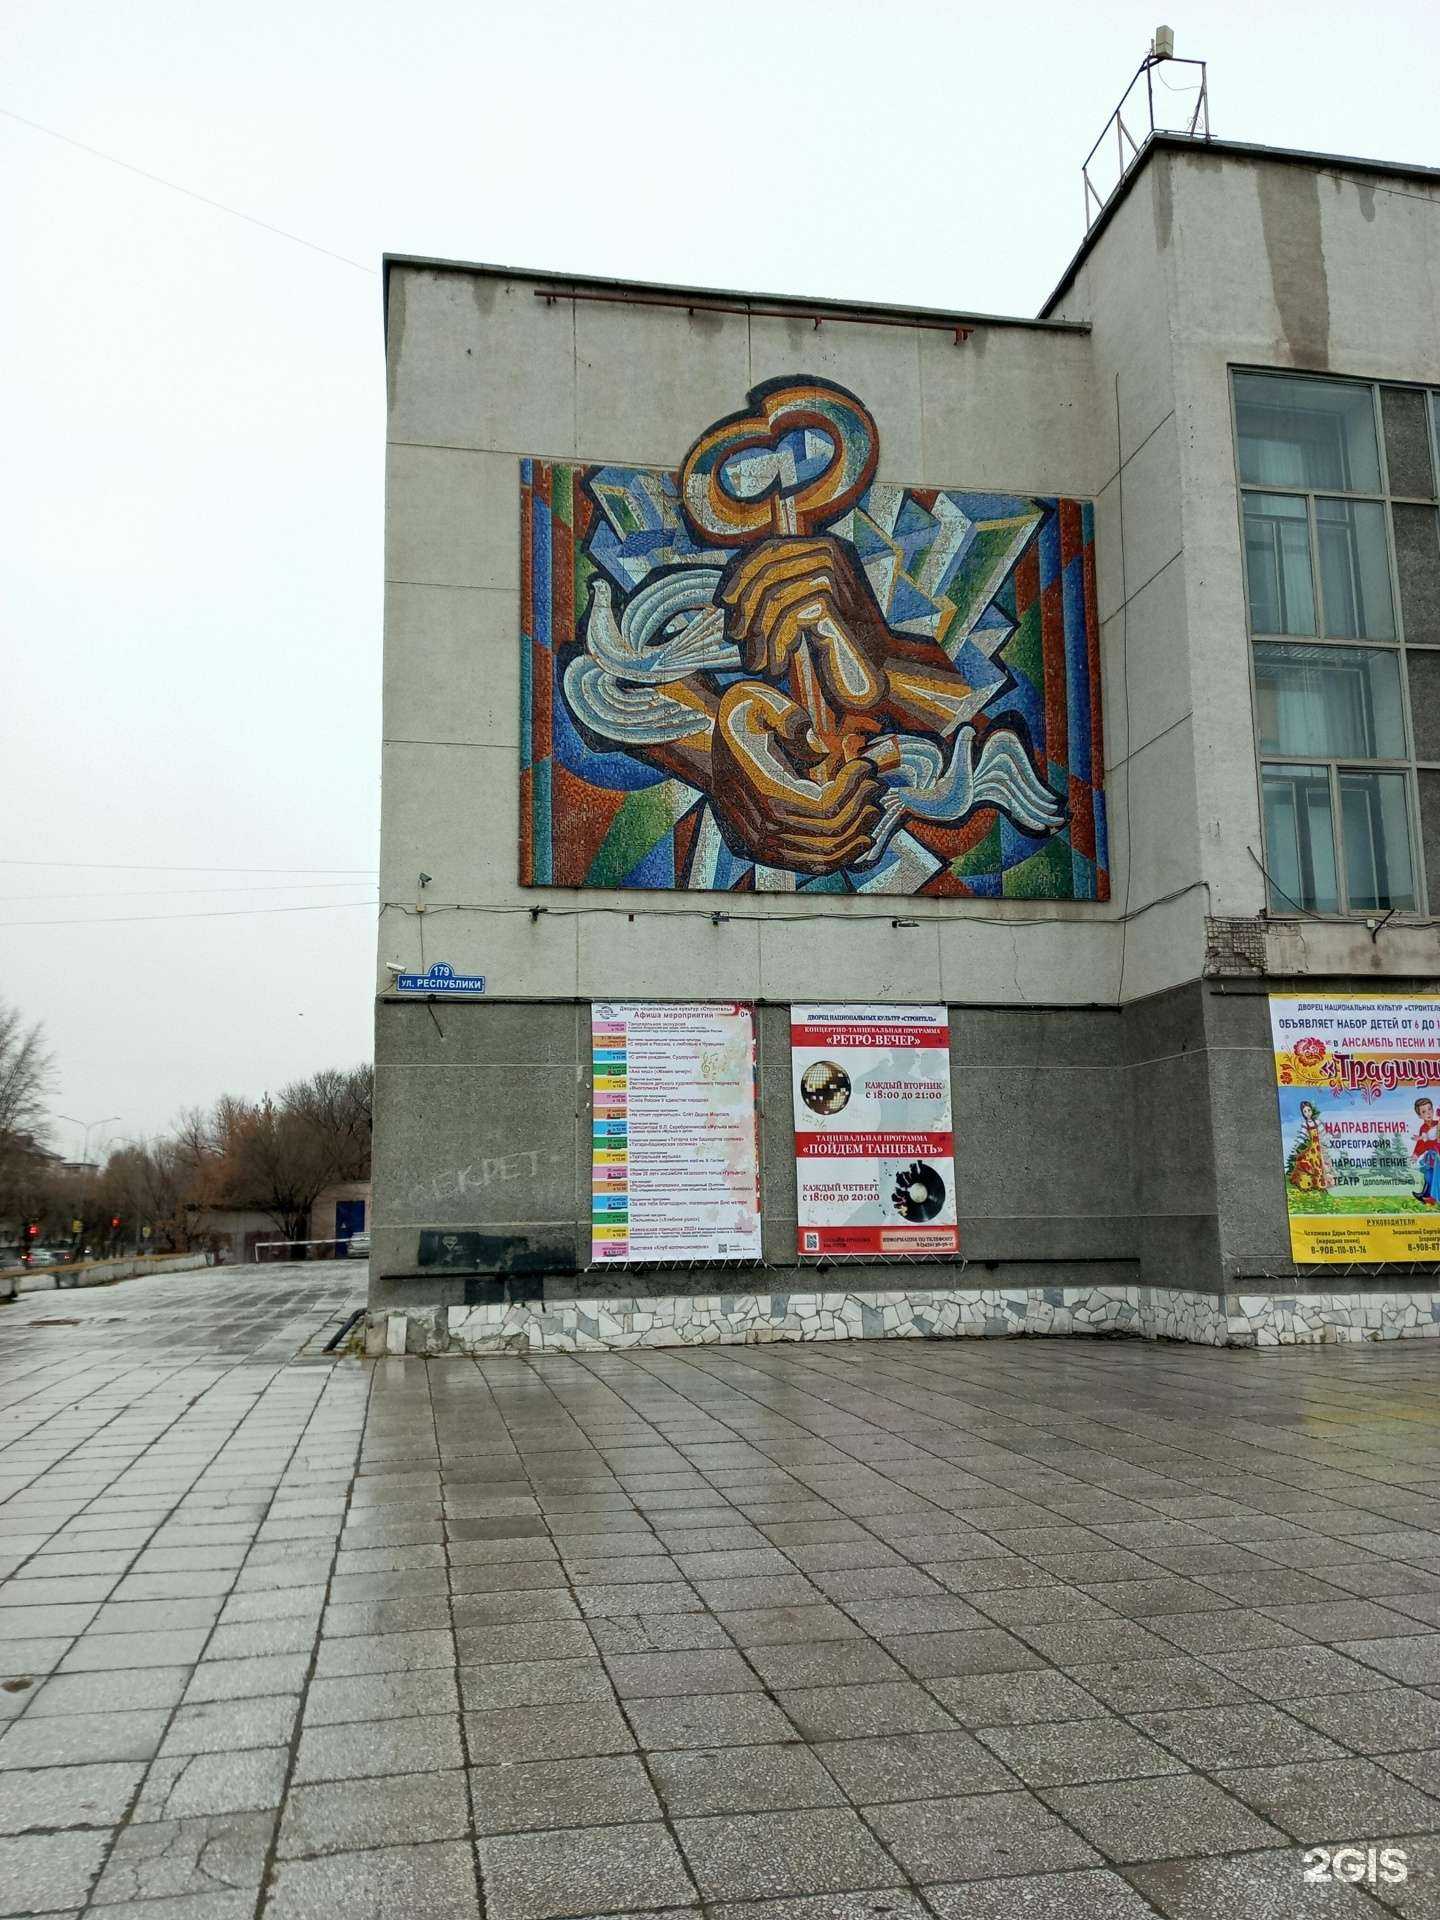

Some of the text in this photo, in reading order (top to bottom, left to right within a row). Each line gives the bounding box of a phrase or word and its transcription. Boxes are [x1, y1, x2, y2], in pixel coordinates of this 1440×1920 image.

[434, 966, 450, 976] 179
[417, 979, 481, 989] РЕСПУБЛИКИ
[1298, 1003, 1324, 1011] ДВОРЕЦ
[1325, 1003, 1375, 1011] НАЦИОНАЛЬНЫХ
[634, 1011, 661, 1019] Афиша
[1279, 1018, 1334, 1029] ОБЪЯВЛЯЕТ
[1337, 1019, 1367, 1029] НАБОР
[1370, 1017, 1399, 1030] ДЕТЕЙ
[1401, 1019, 1412, 1029] ОТ
[1414, 1020, 1420, 1029] 6
[1422, 1019, 1435, 1030] ДО
[826, 1034, 921, 1046] «РЕТРО-ВЕЧЕР»
[1342, 1038, 1393, 1047] АНСАМБЛЬ
[1396, 1038, 1426, 1047] ПЕСНИ
[1428, 1038, 1435, 1047] И
[1321, 1053, 1440, 1089] «Традици
[864, 1080, 943, 1090] КАЖДЫЙ ВТОРНИК
[873, 1091, 900, 1099] 18:00
[901, 1092, 913, 1100] до
[1324, 1121, 1410, 1133] НАПРАВЛЕНИЯ:
[802, 1142, 944, 1155] «ПОЙДЕМ ТАНЦЕВАТЬ»
[1329, 1140, 1391, 1149] ХОРЕОГРАФИЯ
[1331, 1158, 1408, 1168] НАРОДНОЕ ПЕНИЕ
[1333, 1177, 1360, 1186] ТЕАТР
[803, 1183, 842, 1192] КАЖДЫЙ
[809, 1192, 836, 1201] 18:00
[837, 1194, 850, 1202] до
